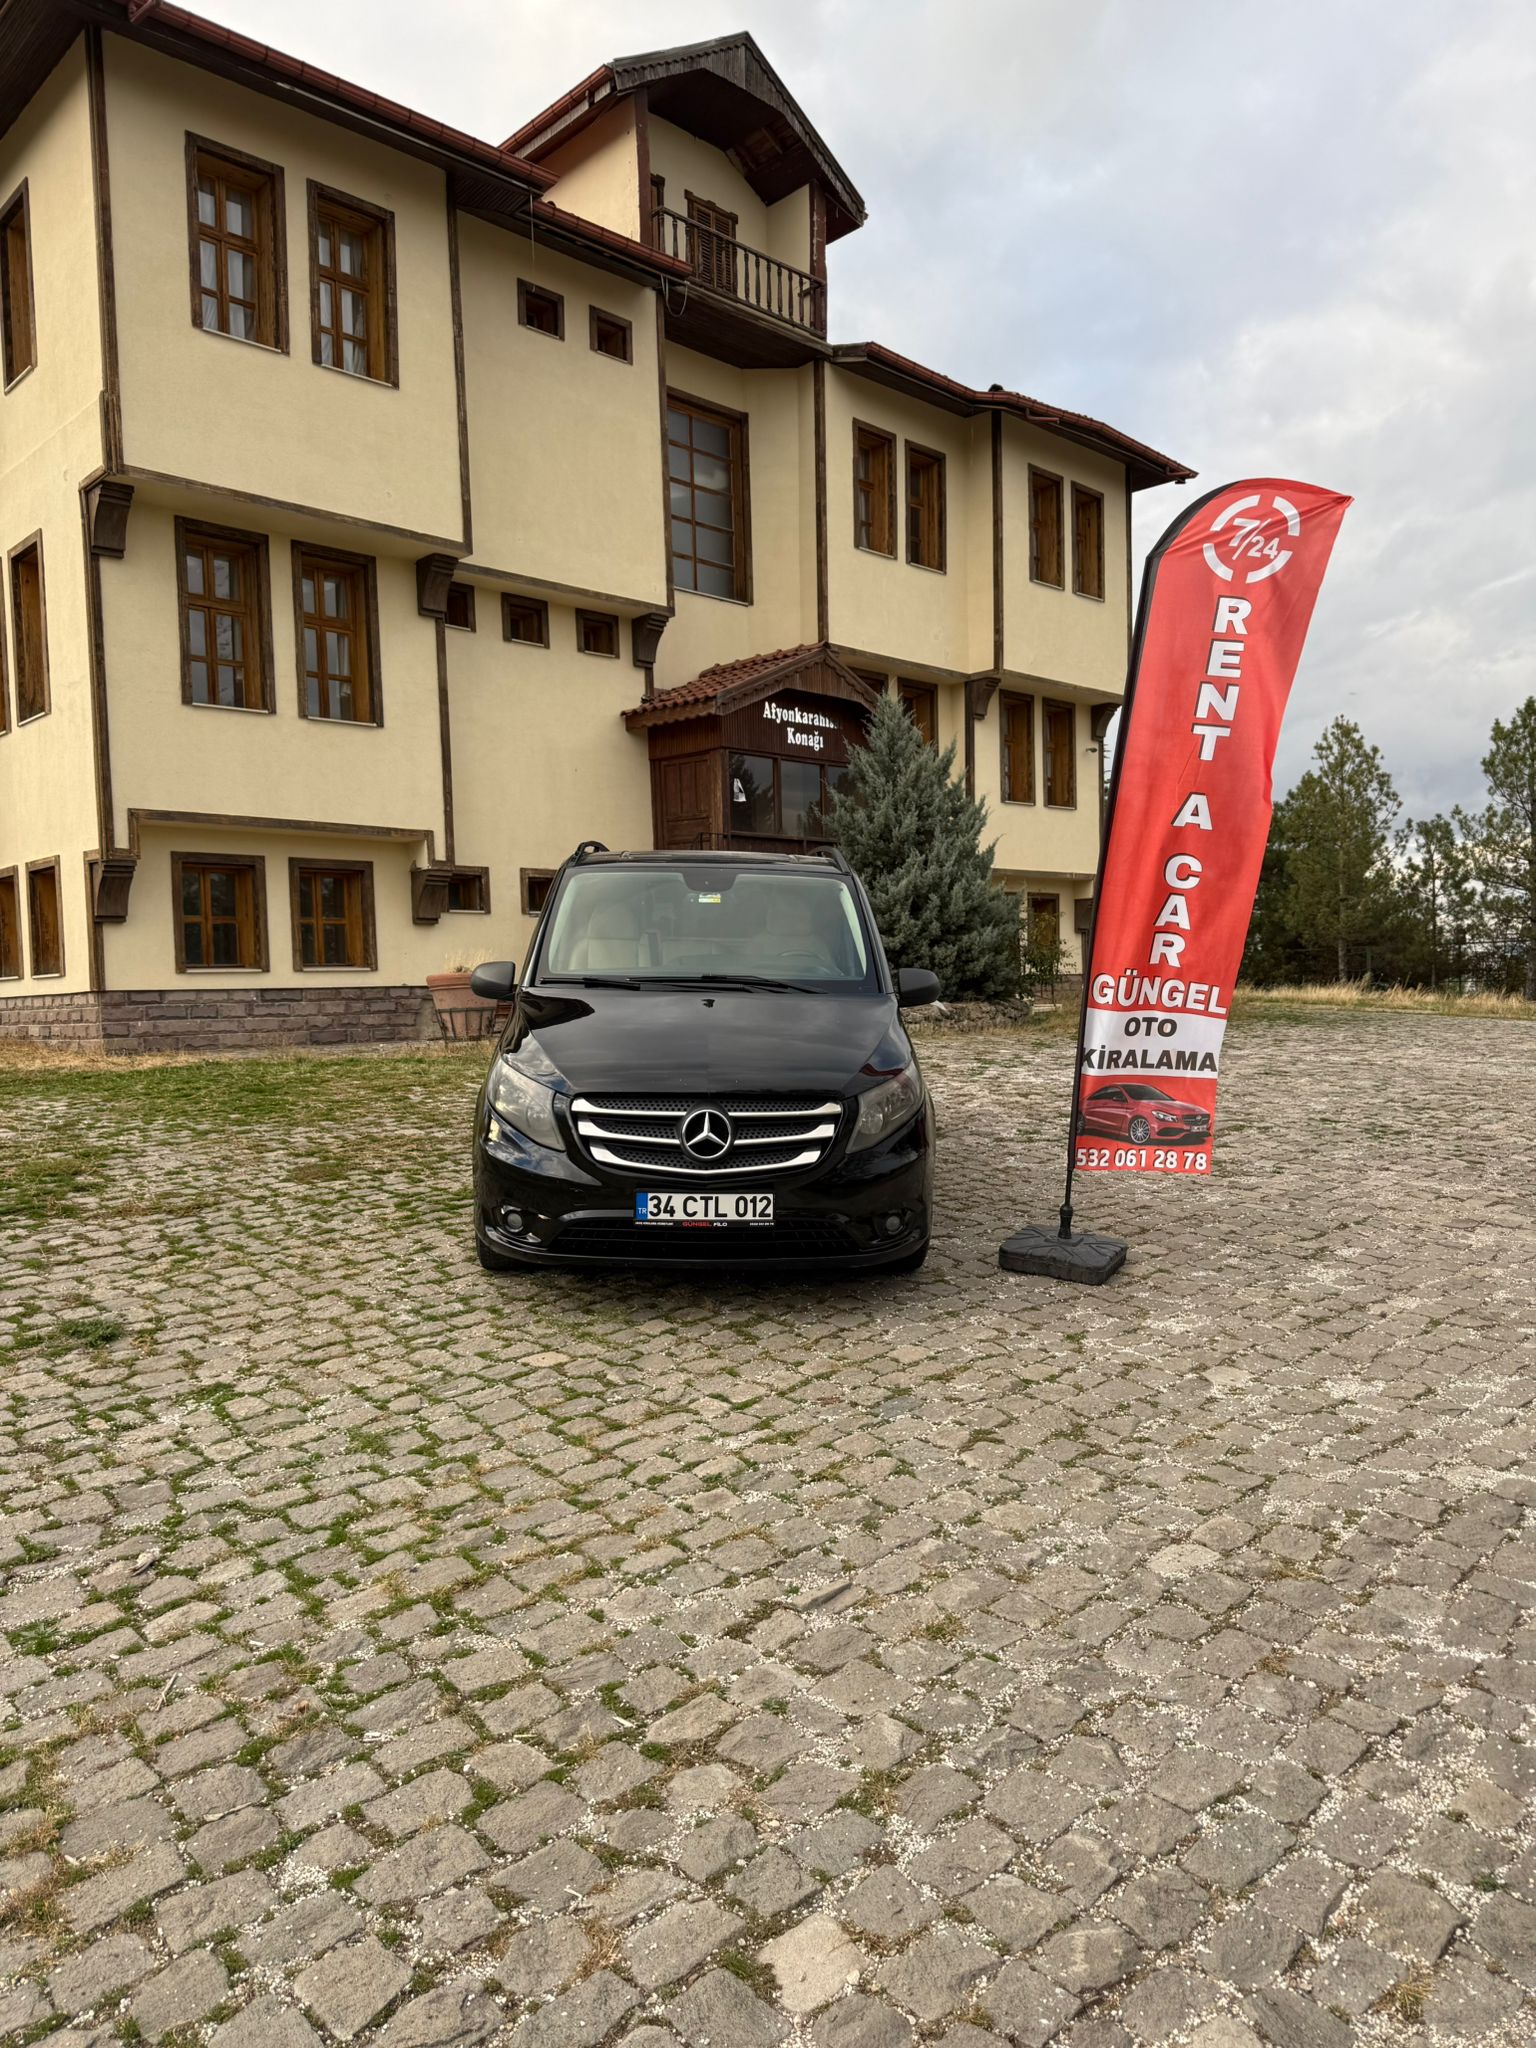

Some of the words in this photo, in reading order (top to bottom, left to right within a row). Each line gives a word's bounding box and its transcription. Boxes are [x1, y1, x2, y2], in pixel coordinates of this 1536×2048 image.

[1228, 518, 1278, 560] 7/24
[1193, 595, 1252, 761] RENT
[763, 701, 840, 730] Afyonkarahi
[786, 727, 824, 752] Konağı
[1171, 793, 1213, 832] A
[1149, 854, 1203, 968] CAR
[1092, 968, 1227, 1015] GÜNGEL
[1124, 1017, 1177, 1038] OTO
[1081, 1044, 1217, 1072] KİRALAMA
[1114, 1149, 1147, 1168] 061
[1153, 1150, 1178, 1169] 28
[1183, 1152, 1207, 1171] 78
[649, 1195, 676, 1217] 34
[683, 1195, 728, 1218] CTL
[735, 1195, 772, 1218] 012
